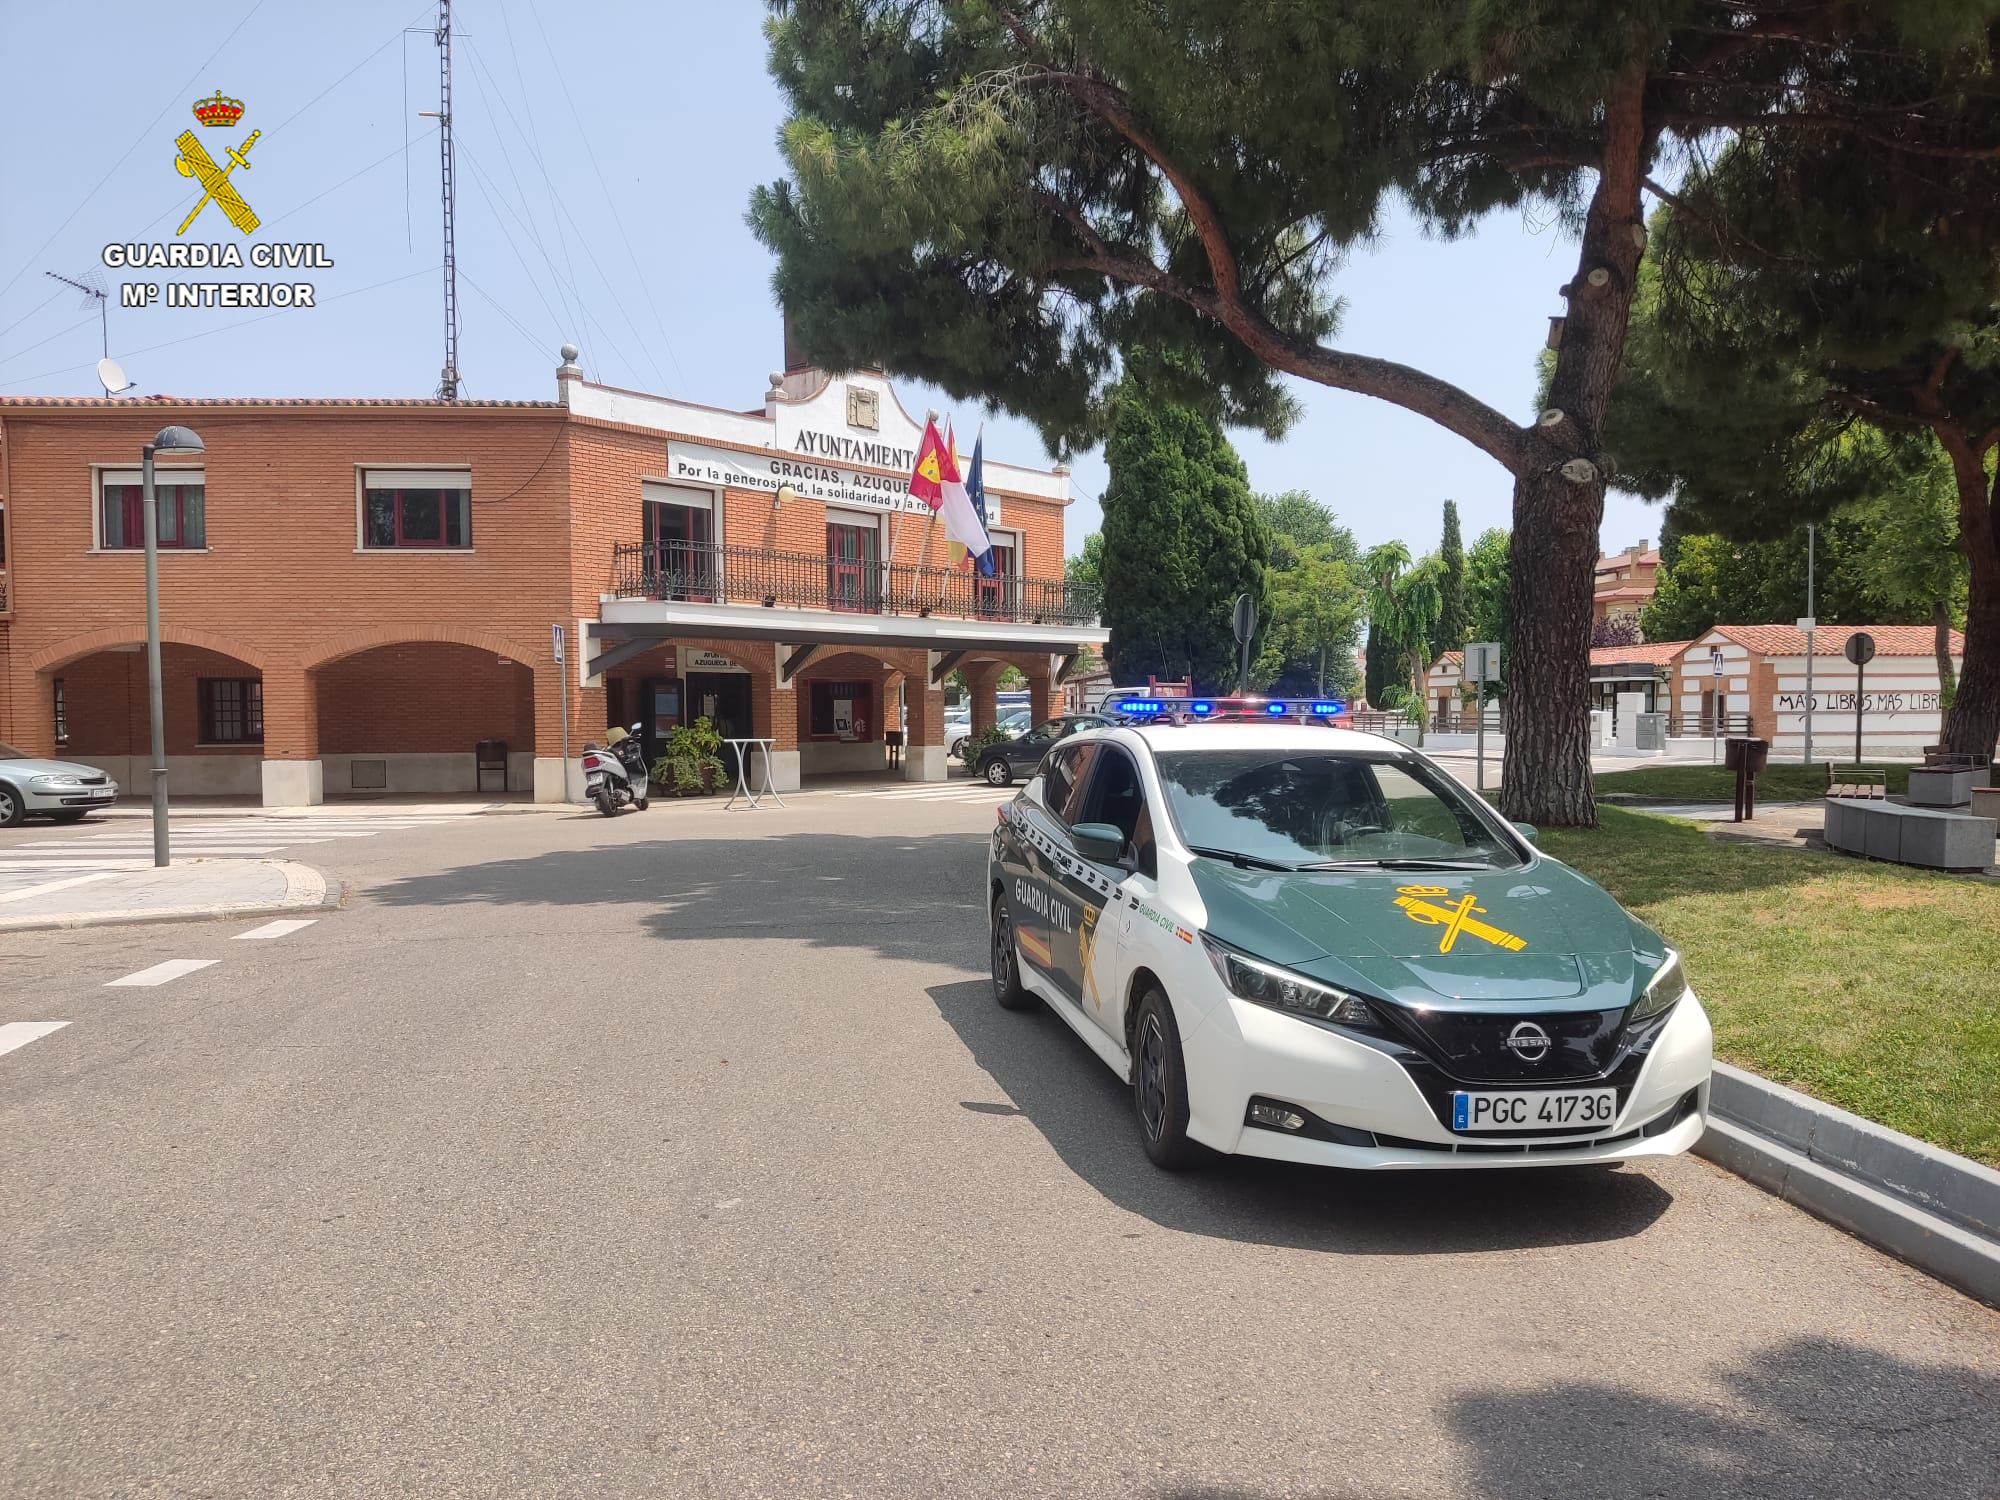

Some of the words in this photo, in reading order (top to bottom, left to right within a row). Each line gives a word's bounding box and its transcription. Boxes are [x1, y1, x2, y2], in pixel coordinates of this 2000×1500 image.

[678, 462, 701, 477] Por
[708, 467, 719, 479] la
[813, 483, 823, 495] la
[828, 488, 890, 505] solidaridad
[894, 498, 900, 509] y
[770, 461, 844, 486] GRACIAS,
[853, 475, 909, 494] AZUQUE
[1015, 878, 1049, 919] GUARDIA
[1050, 898, 1072, 934] CIVIL
[1139, 903, 1160, 924] GUARDIA
[1160, 917, 1175, 933] CIVIL
[1507, 1039, 1551, 1047] NISSAN
[1458, 1115, 1464, 1123] E
[1474, 1097, 1527, 1123] PGC
[1537, 1095, 1612, 1122] 4173G
